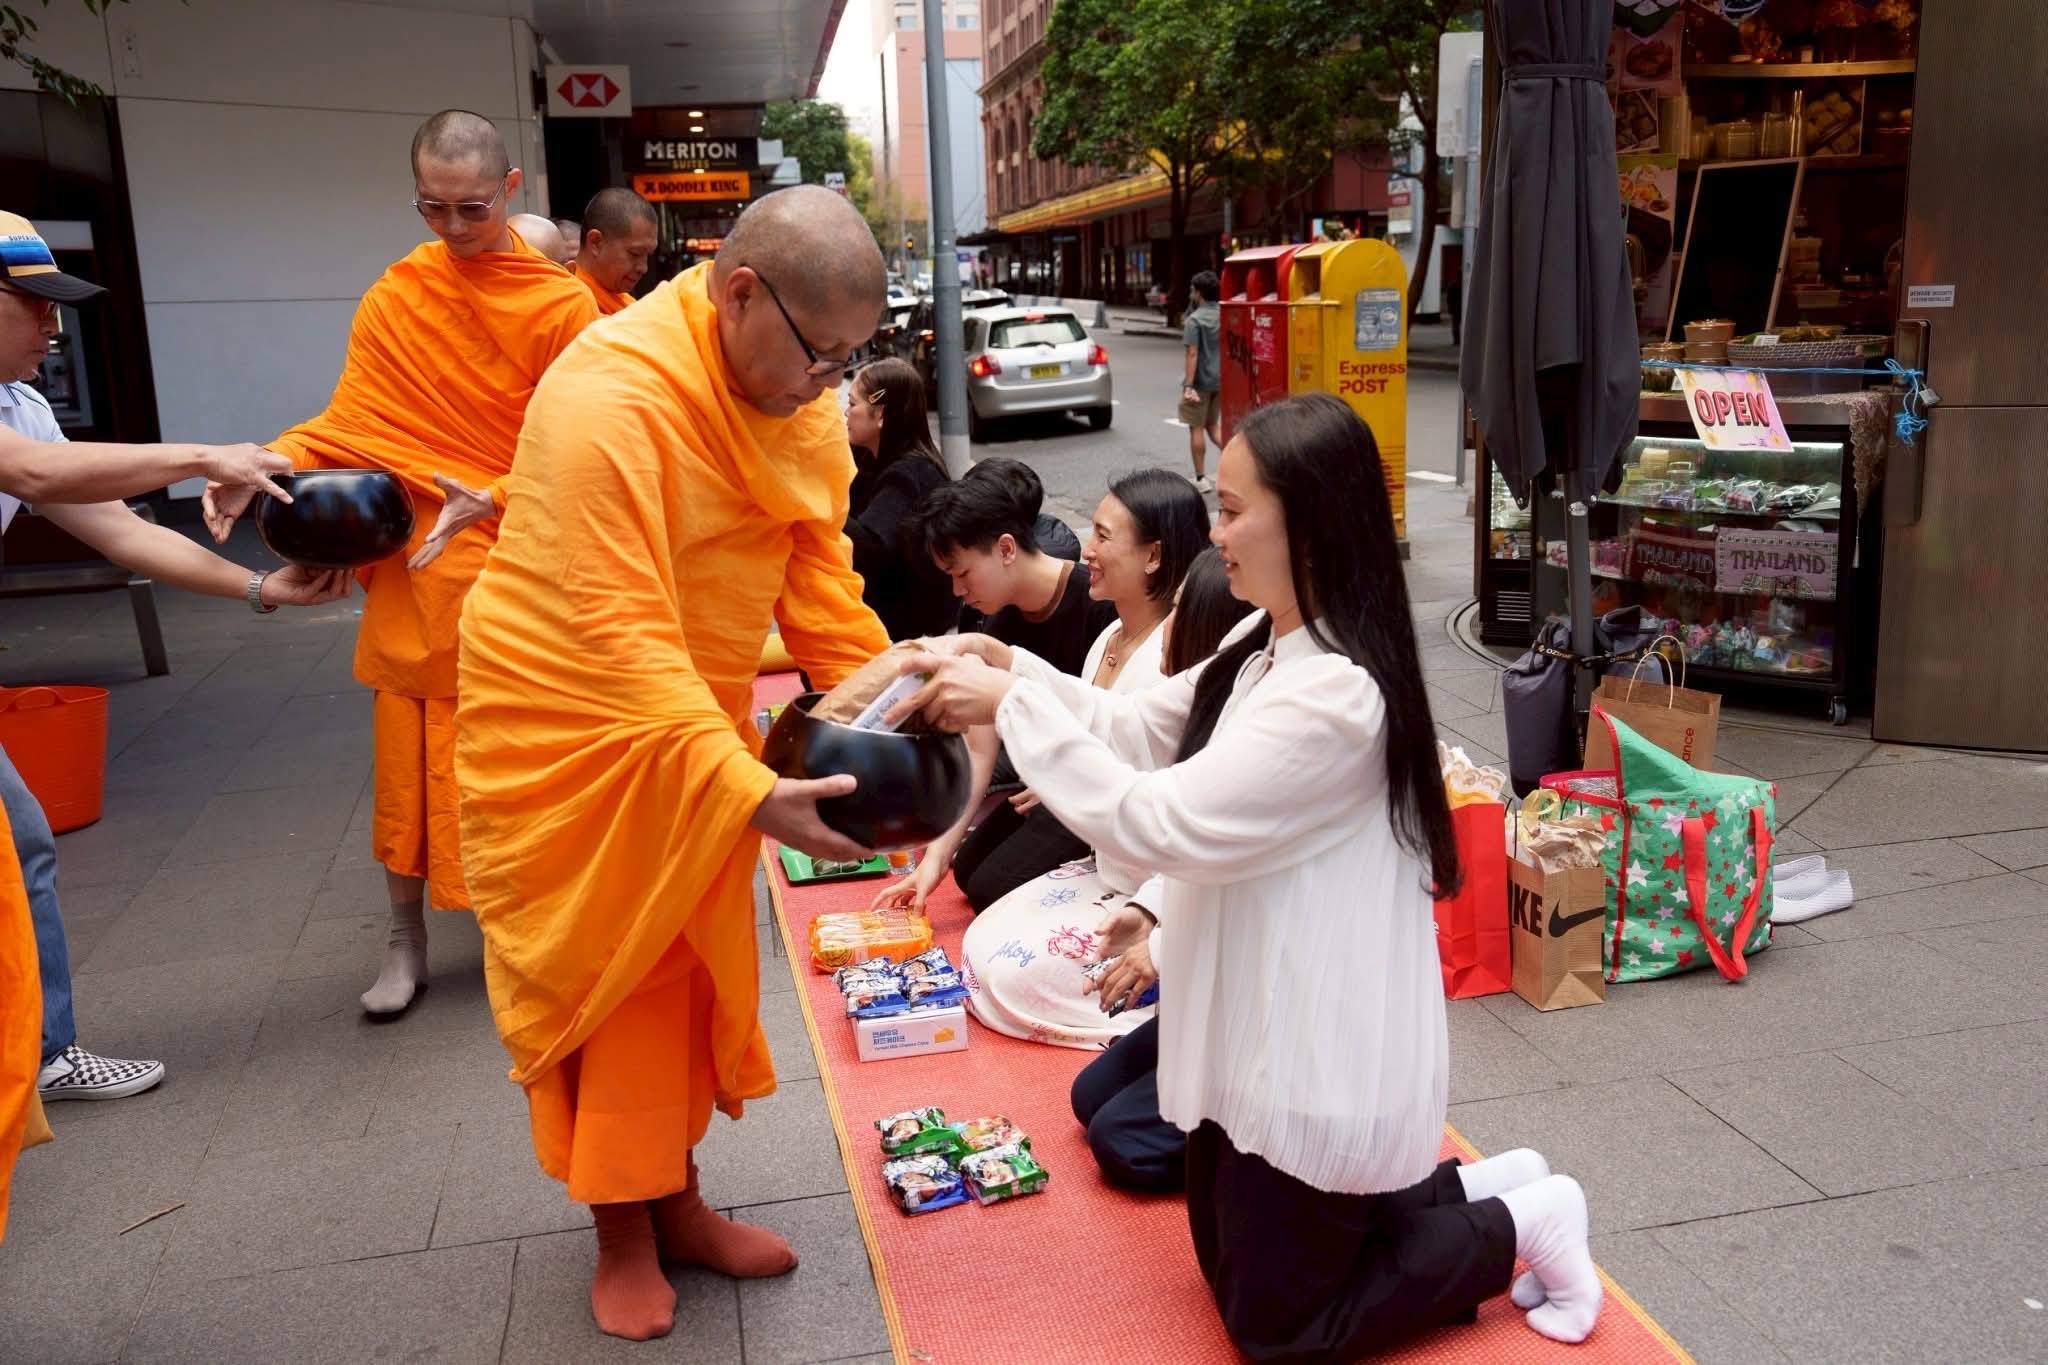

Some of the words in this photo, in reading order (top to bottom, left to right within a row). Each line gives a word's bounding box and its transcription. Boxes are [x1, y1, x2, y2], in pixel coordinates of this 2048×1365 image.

[644, 141, 737, 159] MERITON
[710, 180, 740, 193] KING
[1339, 360, 1407, 378] Express
[1339, 379, 1389, 395] POST
[1694, 389, 1770, 427] OPEN
[1636, 543, 1715, 574] THAILAND
[1729, 549, 1827, 575] THAILAND
[1682, 727, 1695, 762] ance
[987, 939, 1037, 968] Ahoy
